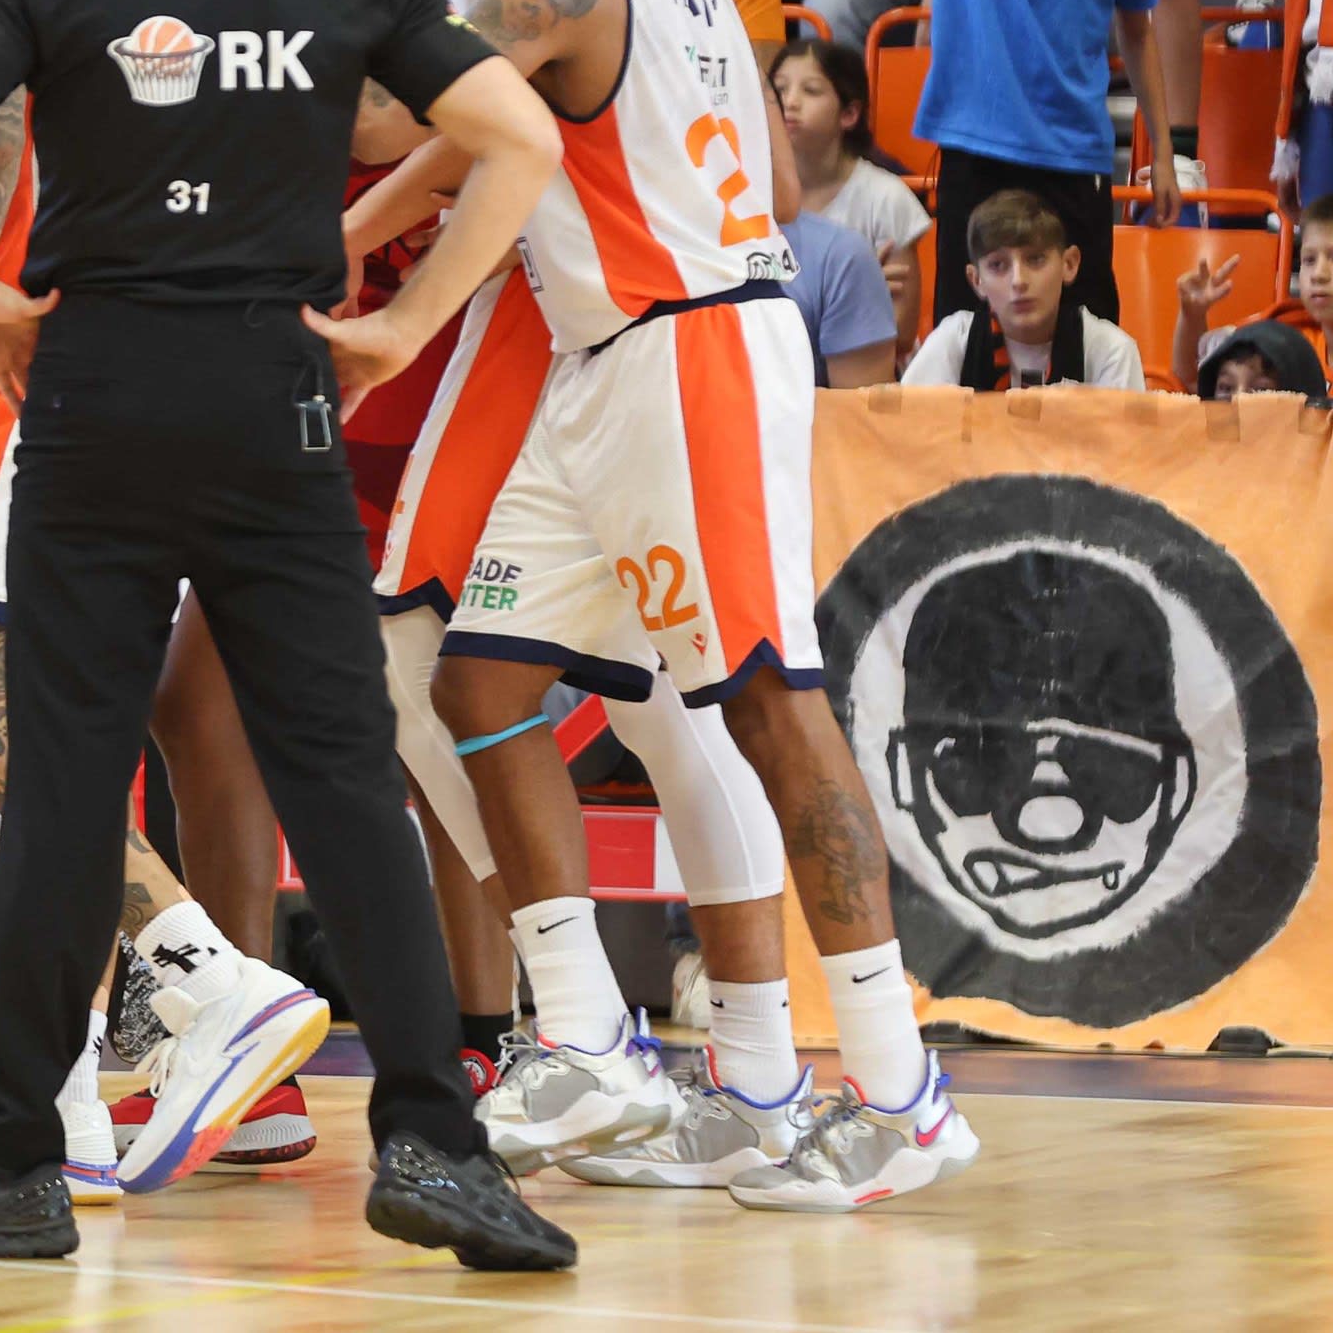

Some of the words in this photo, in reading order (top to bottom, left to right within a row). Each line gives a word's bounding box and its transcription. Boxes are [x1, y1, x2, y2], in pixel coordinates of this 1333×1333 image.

[218, 29, 315, 90] RK
[165, 179, 211, 215] 31
[616, 544, 700, 632] 22
